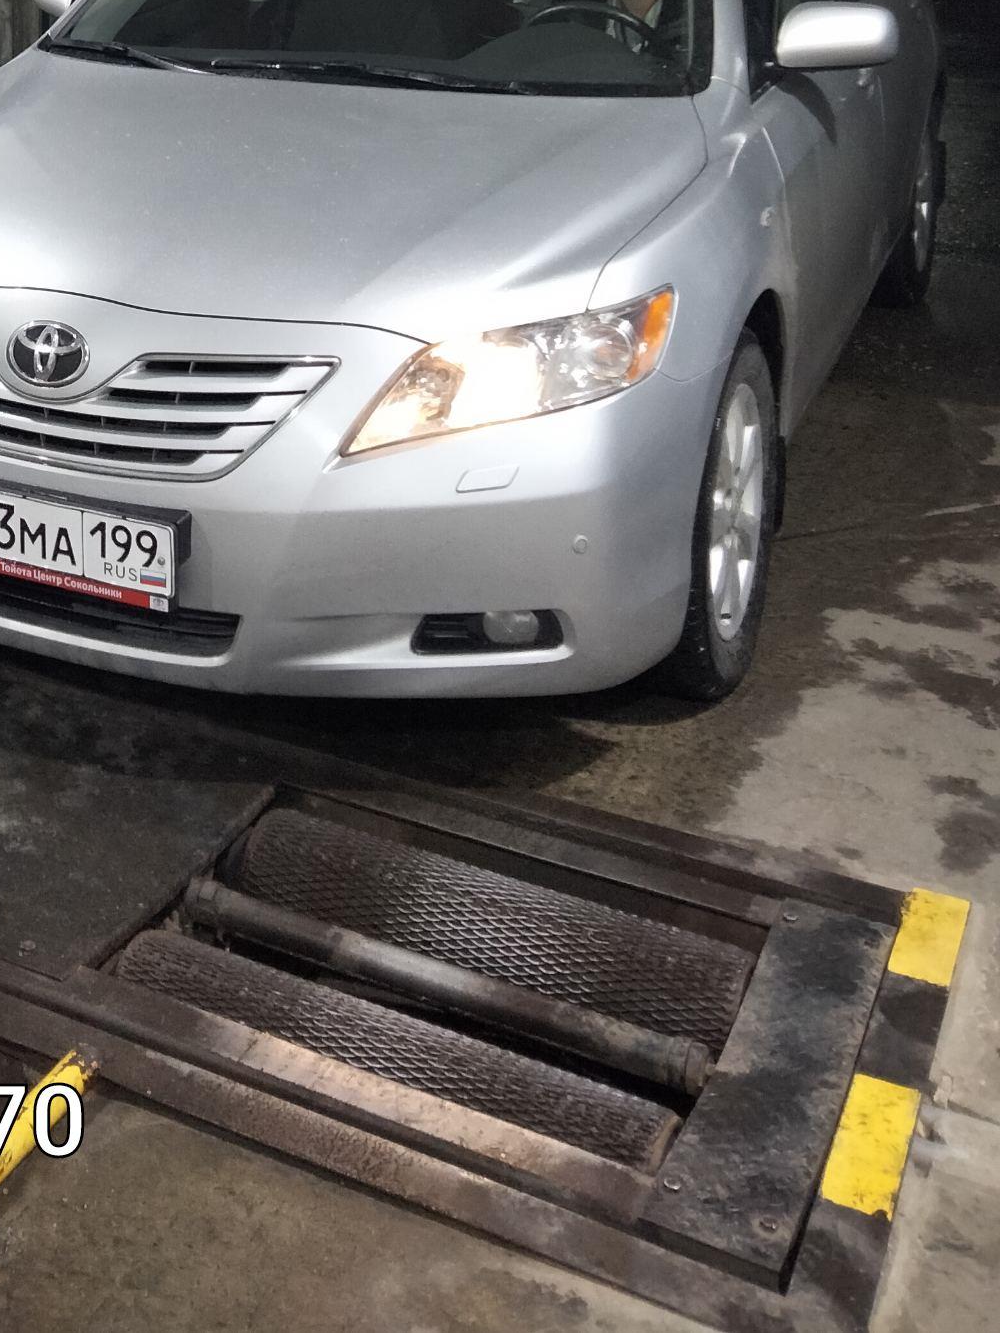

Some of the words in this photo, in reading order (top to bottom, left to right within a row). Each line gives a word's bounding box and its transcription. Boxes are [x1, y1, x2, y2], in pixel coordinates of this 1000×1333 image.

[89, 521, 158, 568] 199
[0, 560, 32, 579] Тойота
[32, 567, 62, 587] Центр
[63, 575, 123, 600] Сокольники
[103, 561, 138, 583] RUS
